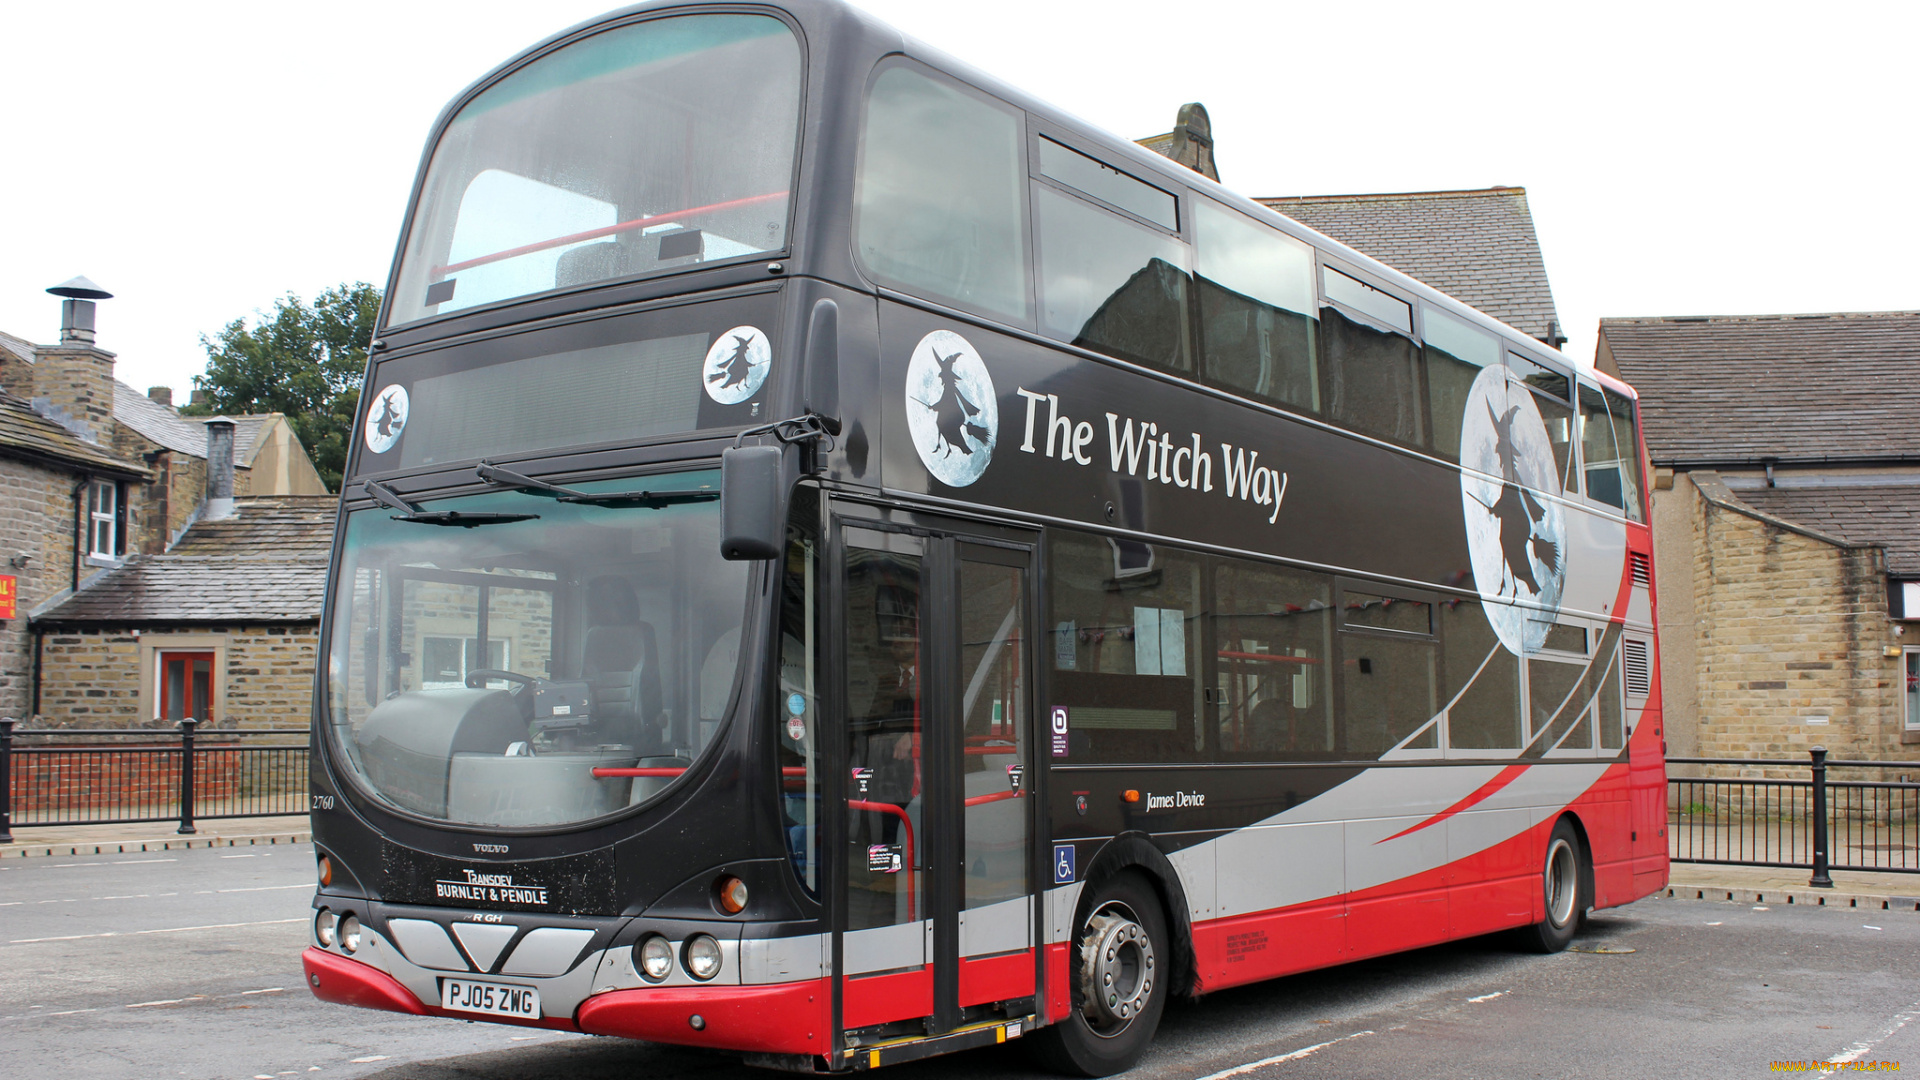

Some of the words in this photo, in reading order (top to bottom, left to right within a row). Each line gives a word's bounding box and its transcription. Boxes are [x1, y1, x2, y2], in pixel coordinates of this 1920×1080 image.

[1017, 386, 1094, 466] The
[1105, 412, 1213, 493] Witch
[1221, 443, 1288, 524] Way
[312, 795, 334, 810] 2760
[1146, 792, 1175, 812] James
[1176, 790, 1205, 808] Device
[473, 843, 509, 854] VOLVO
[436, 884, 486, 901] BURNLEY
[489, 888, 499, 901] &
[500, 889, 548, 905] PENDLE
[450, 983, 494, 1010] PJ05
[499, 988, 533, 1014] ZWG
